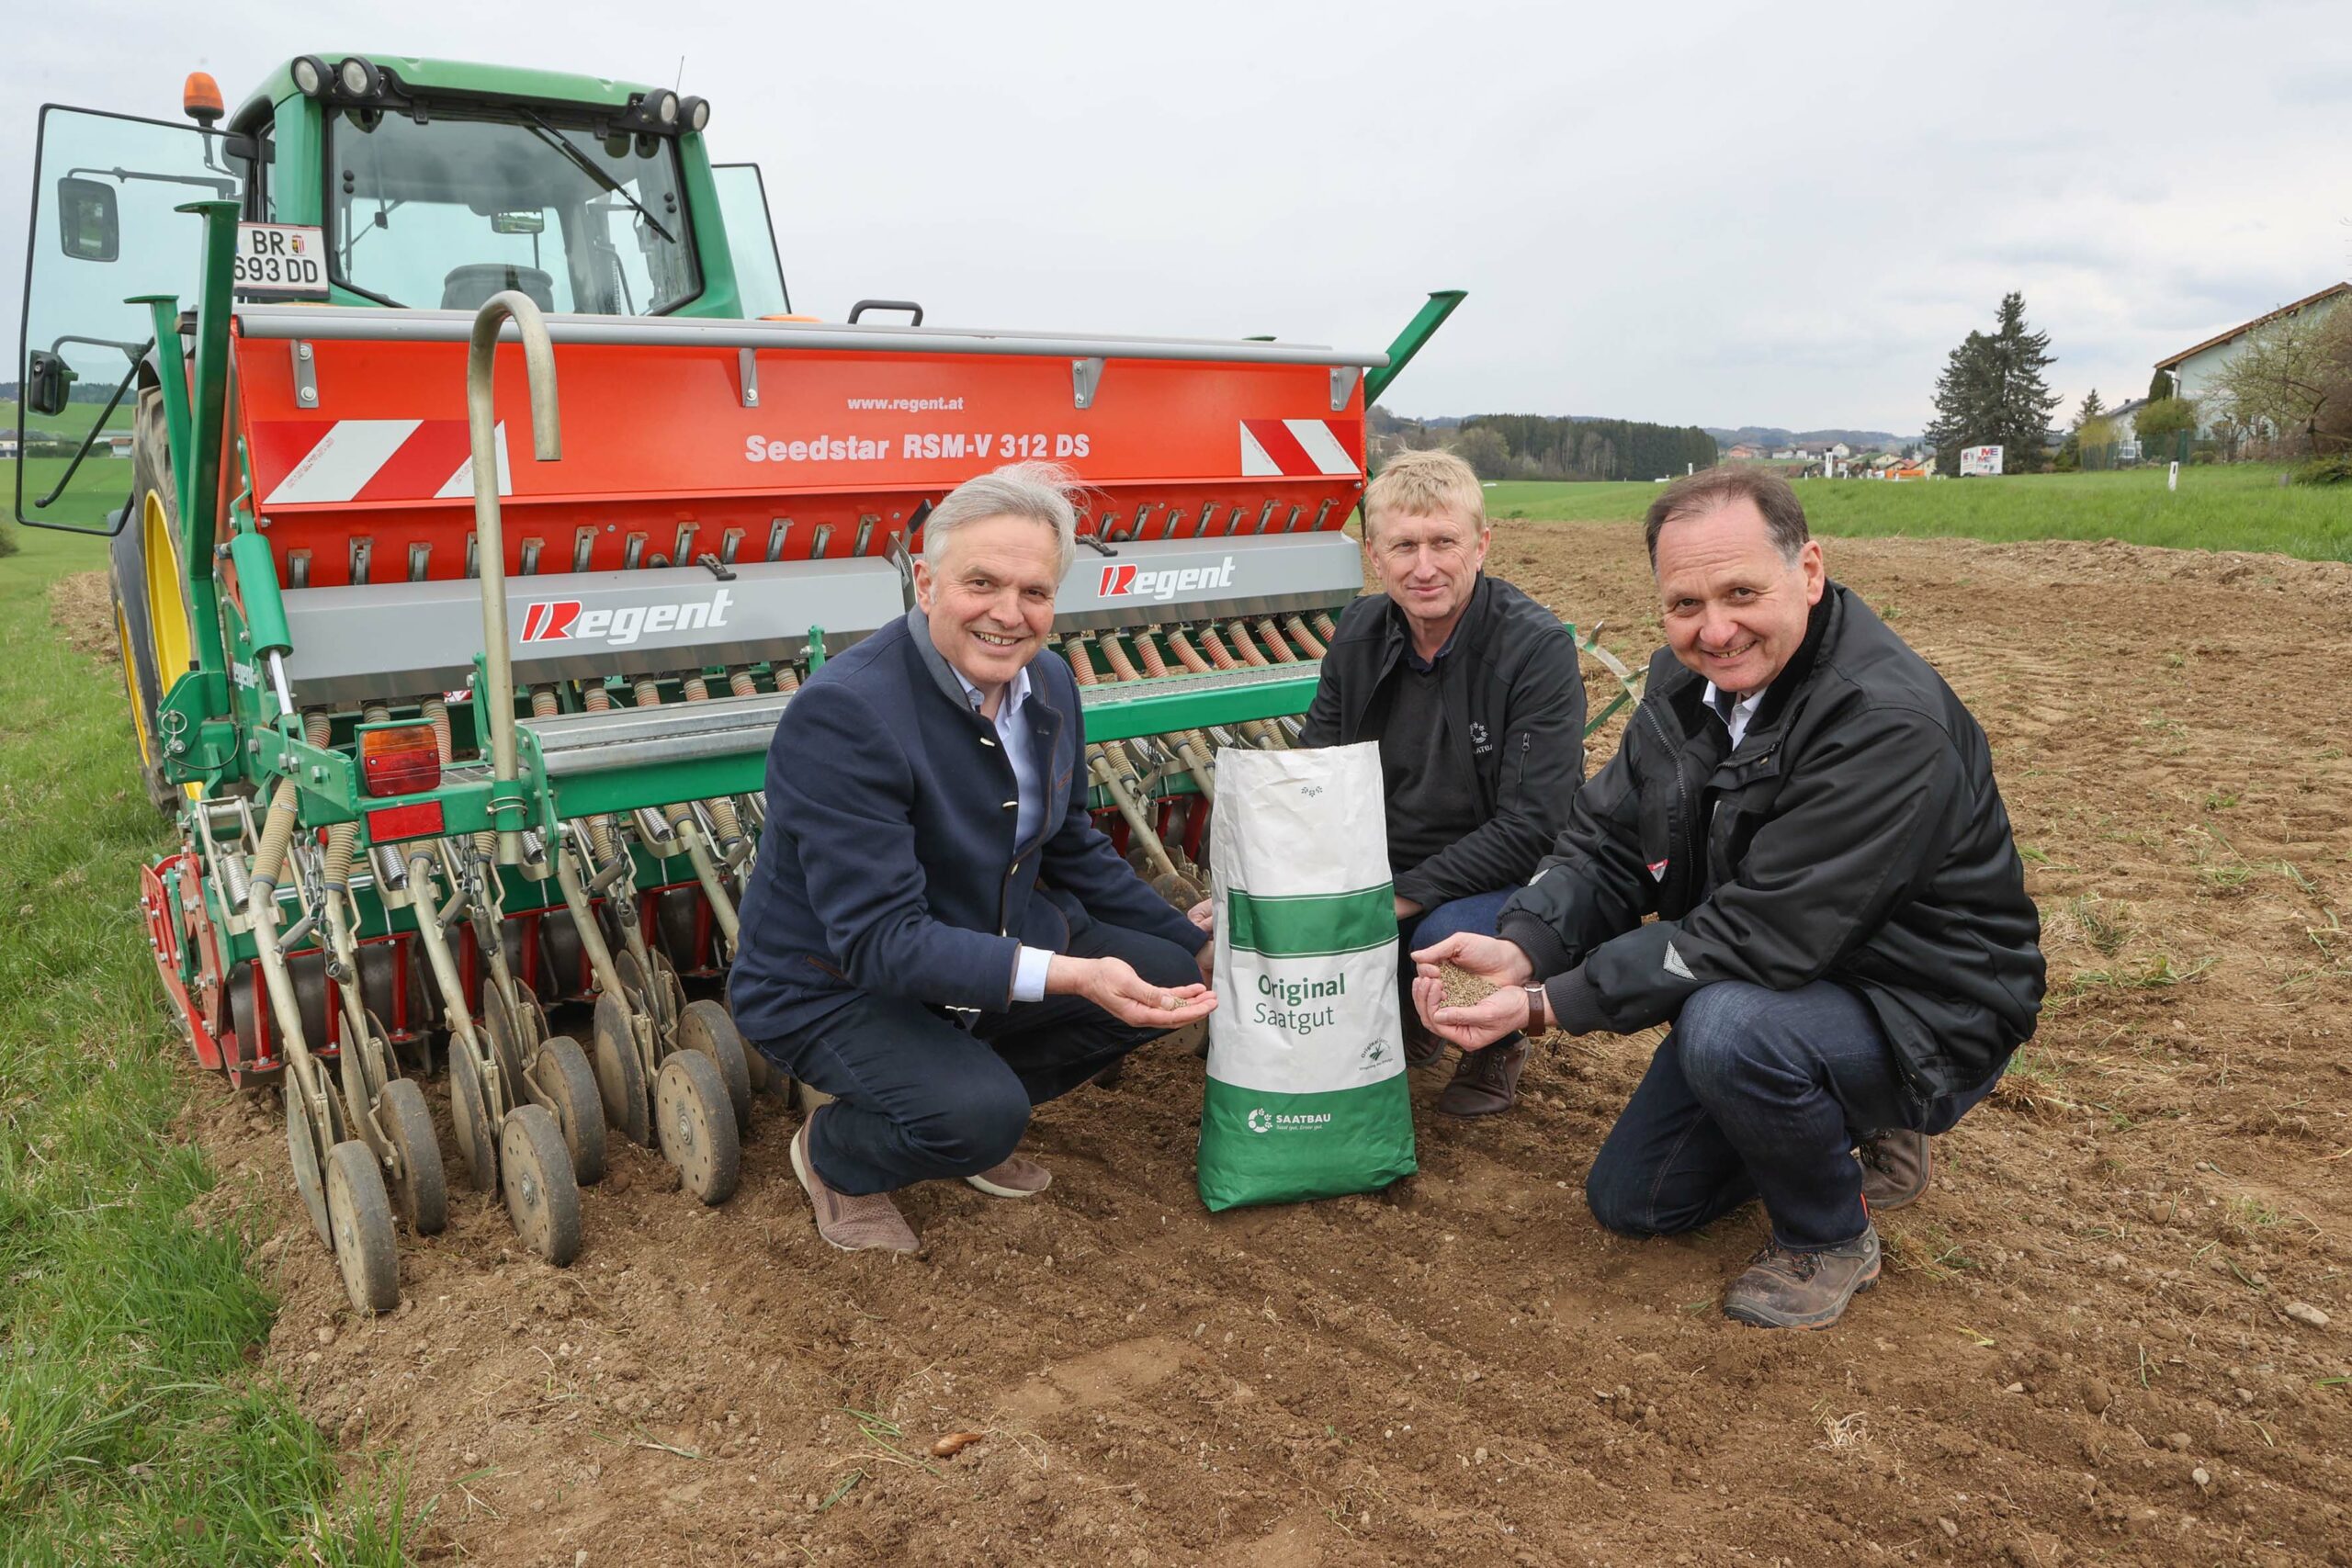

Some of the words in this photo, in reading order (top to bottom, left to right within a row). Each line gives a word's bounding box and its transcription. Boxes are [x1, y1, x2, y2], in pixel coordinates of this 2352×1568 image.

[252, 230, 286, 255] BR
[285, 258, 318, 284] DD
[847, 397, 964, 412] www.regent.at
[745, 434, 889, 462] Seedstar
[903, 434, 992, 458] RSM-V
[1000, 434, 1047, 458] 312
[1056, 434, 1091, 457] DS
[1098, 556, 1236, 601] Regent
[519, 589, 734, 646] Regent
[1258, 972, 1345, 1007] Original
[1253, 1002, 1335, 1035] Saatgut
[1275, 1113, 1331, 1124] SAATBAU
